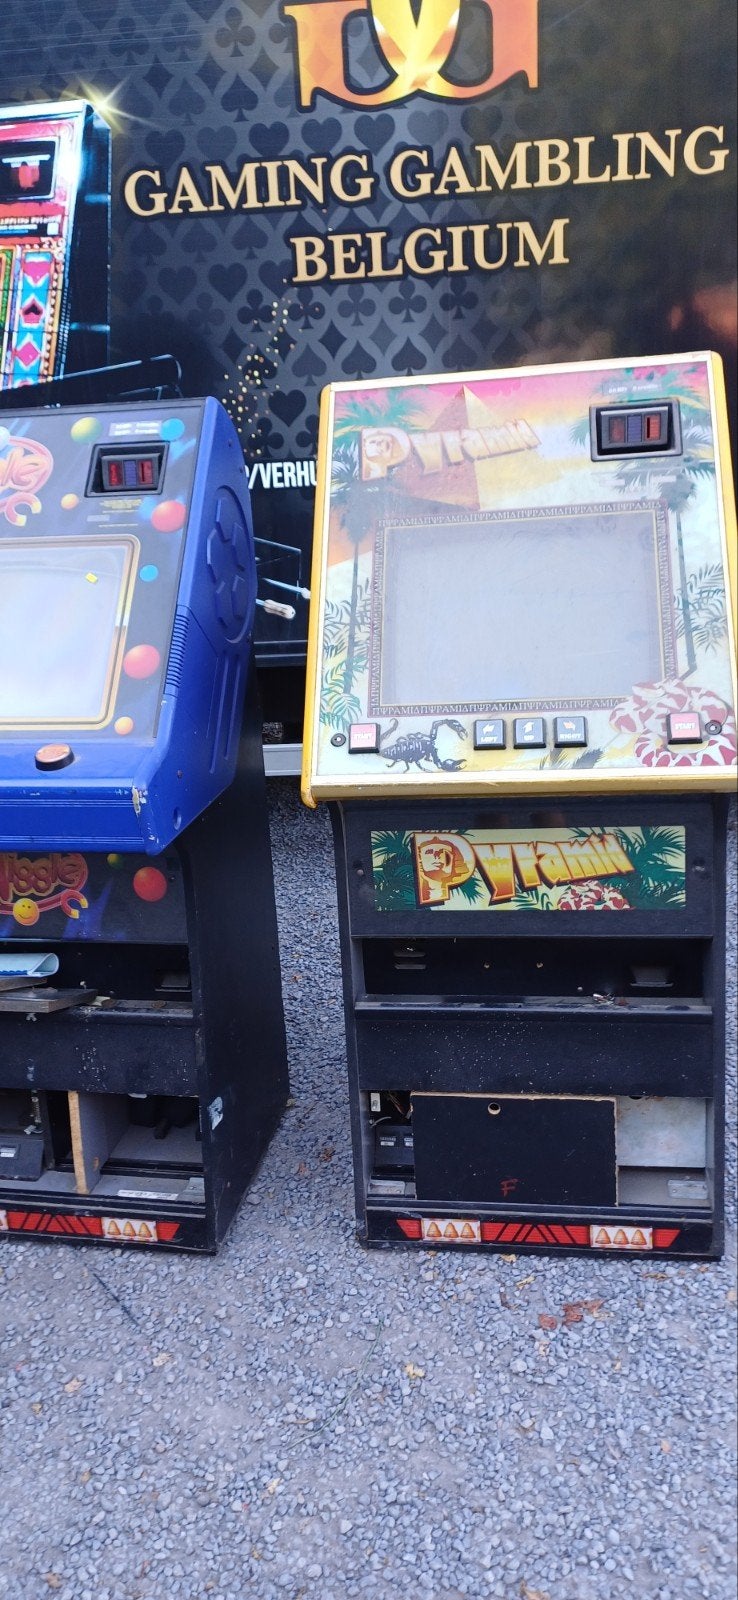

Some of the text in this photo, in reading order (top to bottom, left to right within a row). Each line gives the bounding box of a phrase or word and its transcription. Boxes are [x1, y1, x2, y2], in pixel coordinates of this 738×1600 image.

[124, 125, 730, 217] GAMING GAMBLING
[290, 218, 571, 283] BELGIUM
